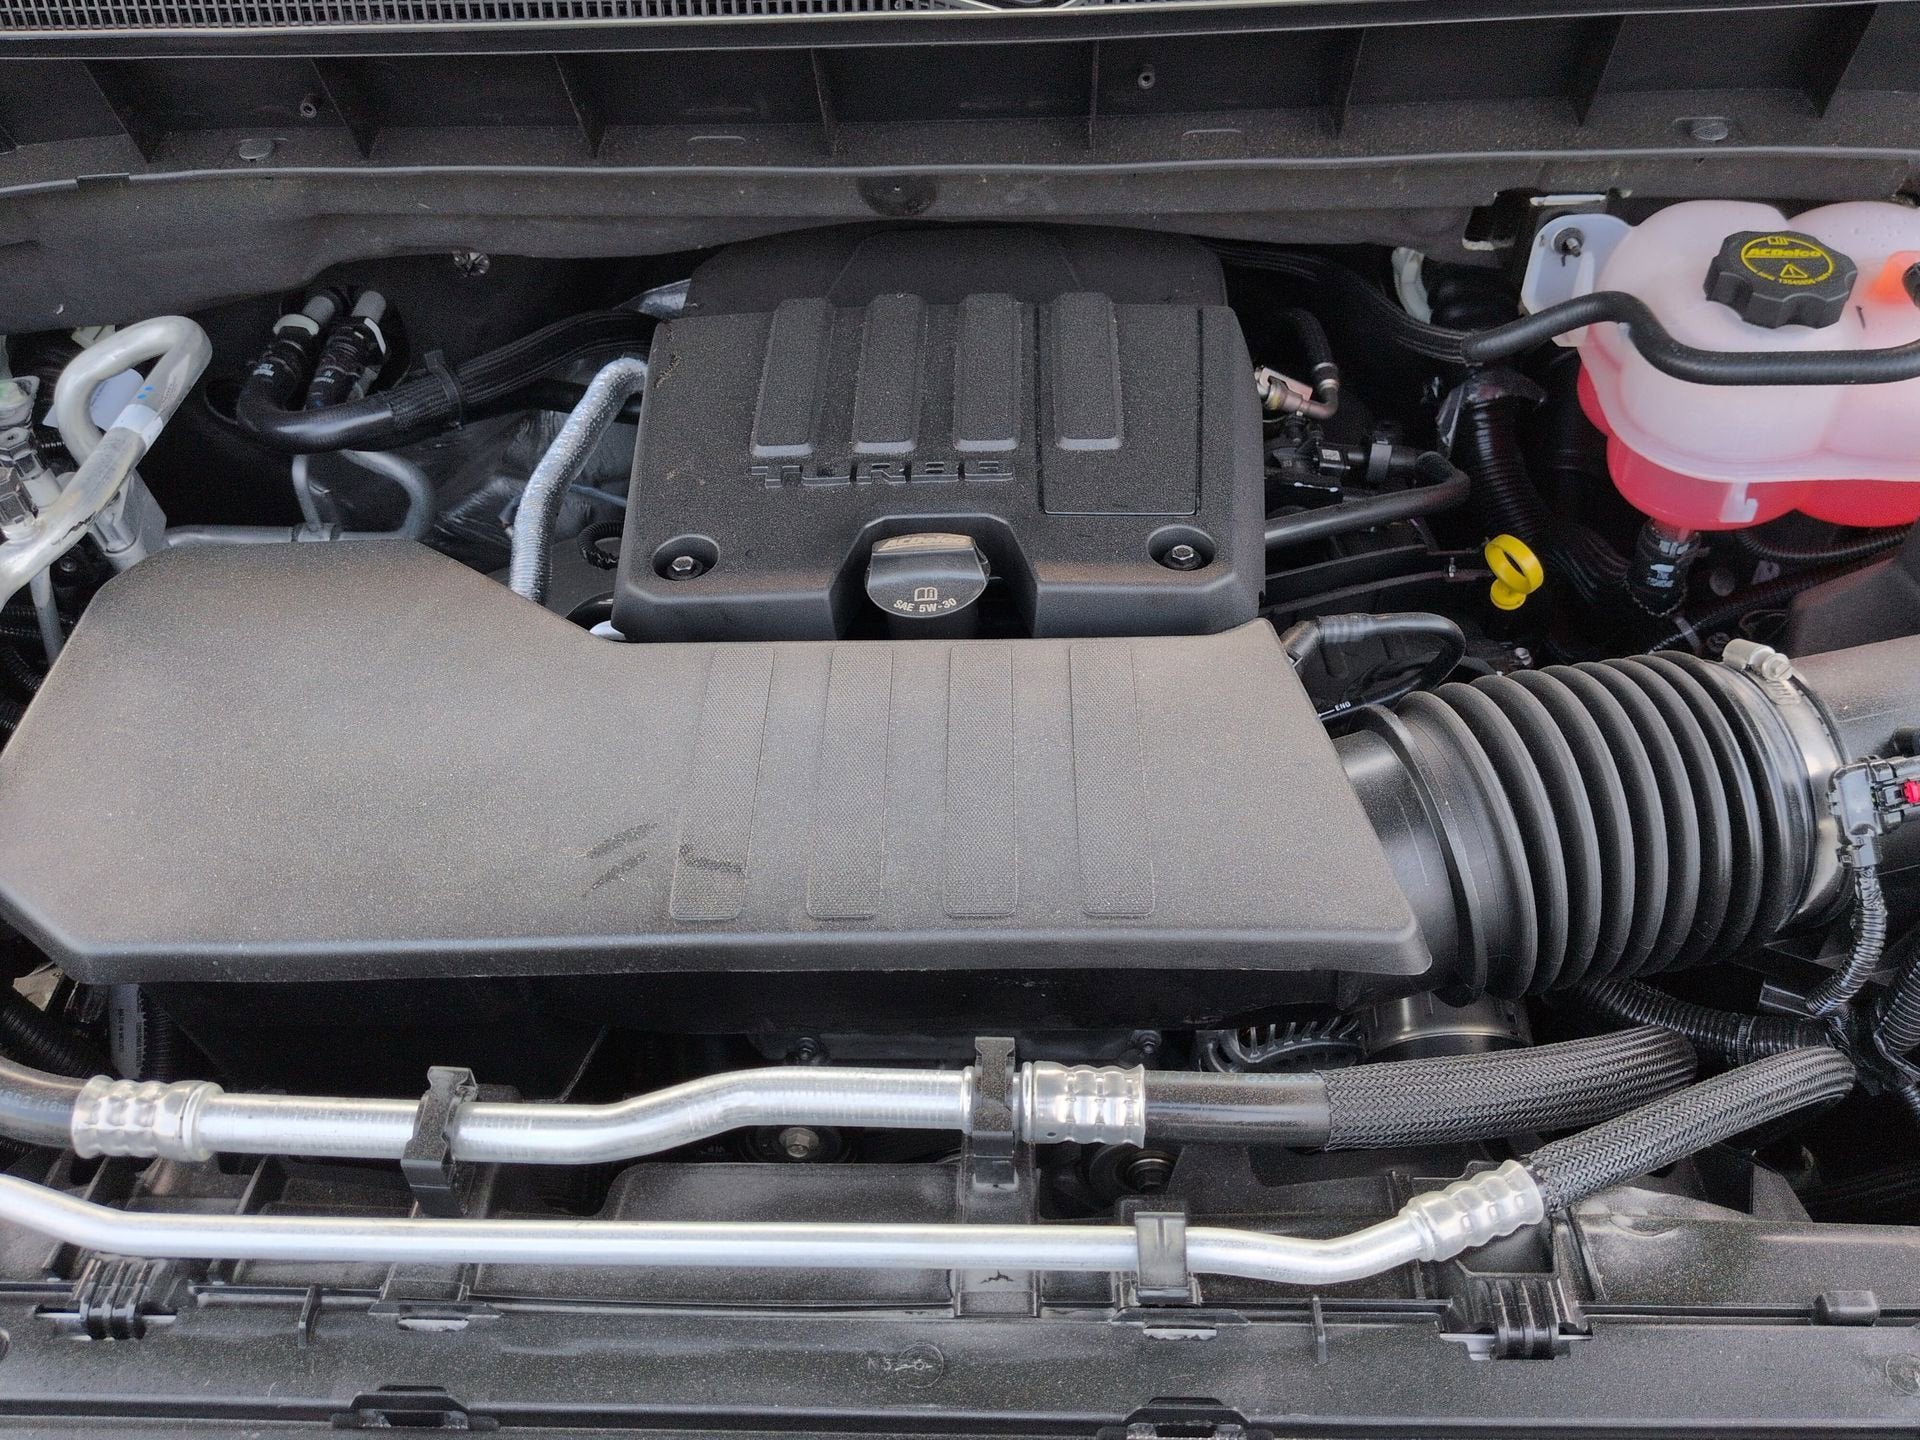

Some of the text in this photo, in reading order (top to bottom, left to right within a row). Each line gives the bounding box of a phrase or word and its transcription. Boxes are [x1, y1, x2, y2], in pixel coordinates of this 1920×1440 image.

[1745, 247, 1822, 258] ACDelco
[750, 459, 1014, 488] TURBO
[879, 535, 970, 550] ACDelco
[893, 597, 957, 613] SAE 5W-30
